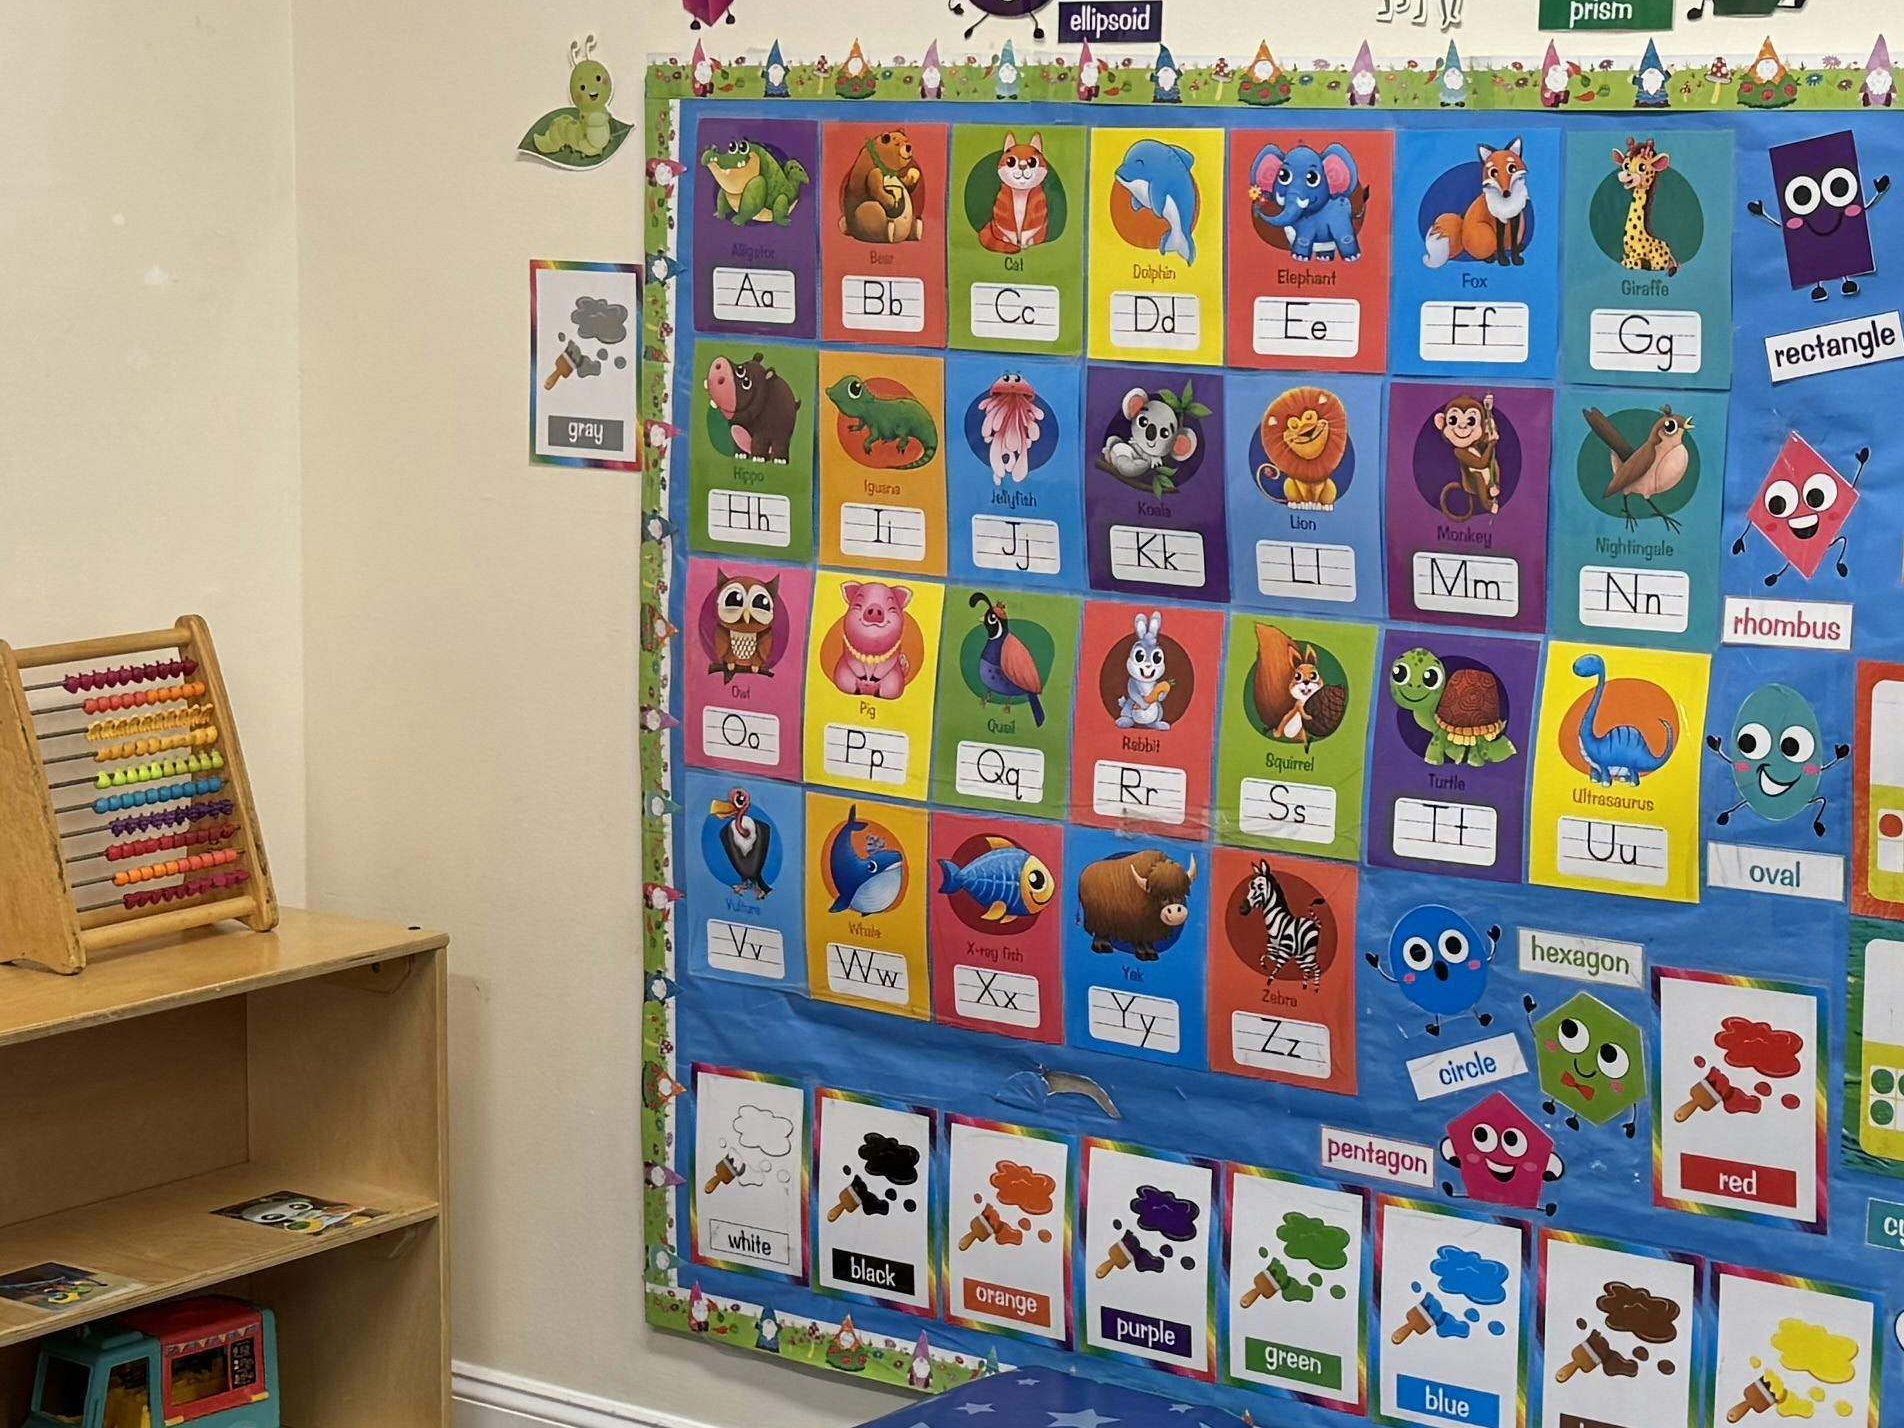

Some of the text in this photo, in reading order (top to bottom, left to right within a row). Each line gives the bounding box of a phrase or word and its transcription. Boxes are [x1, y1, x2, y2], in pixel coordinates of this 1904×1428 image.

[1070, 4, 1151, 35] ellipsoid
[1004, 256, 1024, 272] Cat
[1133, 264, 1176, 282] Dolphin
[1277, 270, 1336, 286] Elephant
[1462, 274, 1487, 289] Fox
[735, 273, 773, 308] Aa
[863, 281, 903, 316] Bb
[1621, 280, 1669, 297] Giraffe
[995, 289, 1035, 325] Cc
[1134, 296, 1176, 334] Dd
[1283, 303, 1327, 341] Ee
[1452, 307, 1497, 345] Ff
[1619, 315, 1674, 371] Gg
[1775, 321, 1895, 367] rectangle
[569, 422, 603, 443] gray
[728, 494, 770, 532] Hh
[873, 509, 892, 543] Ii
[1290, 515, 1317, 531] Lion
[1002, 522, 1030, 570] Jj
[1136, 533, 1177, 571] Kk
[1437, 526, 1492, 546] Monkey
[1596, 537, 1674, 558] Nightingale
[1291, 548, 1321, 586] Ll
[1430, 559, 1500, 601] Mm
[1606, 573, 1661, 615] Nn
[1733, 607, 1841, 640] rhombus
[860, 701, 876, 719] Pig
[722, 714, 760, 749] Oo
[1122, 736, 1160, 754] Rabbit
[846, 730, 884, 779] Pp
[1265, 752, 1314, 772] Squirrel
[977, 748, 1022, 800] Qq
[1120, 767, 1158, 806] Rr
[1428, 774, 1465, 791] Turtle
[1269, 785, 1306, 824] Ss
[1572, 788, 1654, 811] Ultrasaurus
[1422, 804, 1467, 844] Tt
[1586, 824, 1636, 866] Uu
[1750, 862, 1801, 888] oval
[727, 925, 762, 961] Vv
[1532, 936, 1630, 974] hexagon
[836, 946, 897, 988] Ww
[977, 971, 1016, 1010] Xx
[1263, 990, 1297, 1007] Zebra
[1111, 993, 1156, 1047] Yy
[1260, 1018, 1301, 1058] Zz
[1440, 1052, 1496, 1086] circle
[1328, 1140, 1427, 1175] pentagon
[1718, 1171, 1758, 1196] red
[729, 1232, 771, 1255] white
[851, 1262, 896, 1287] black
[976, 1288, 1038, 1315] orange
[1117, 1318, 1175, 1347] purple
[1264, 1345, 1322, 1374] green
[1425, 1387, 1470, 1418] blue
